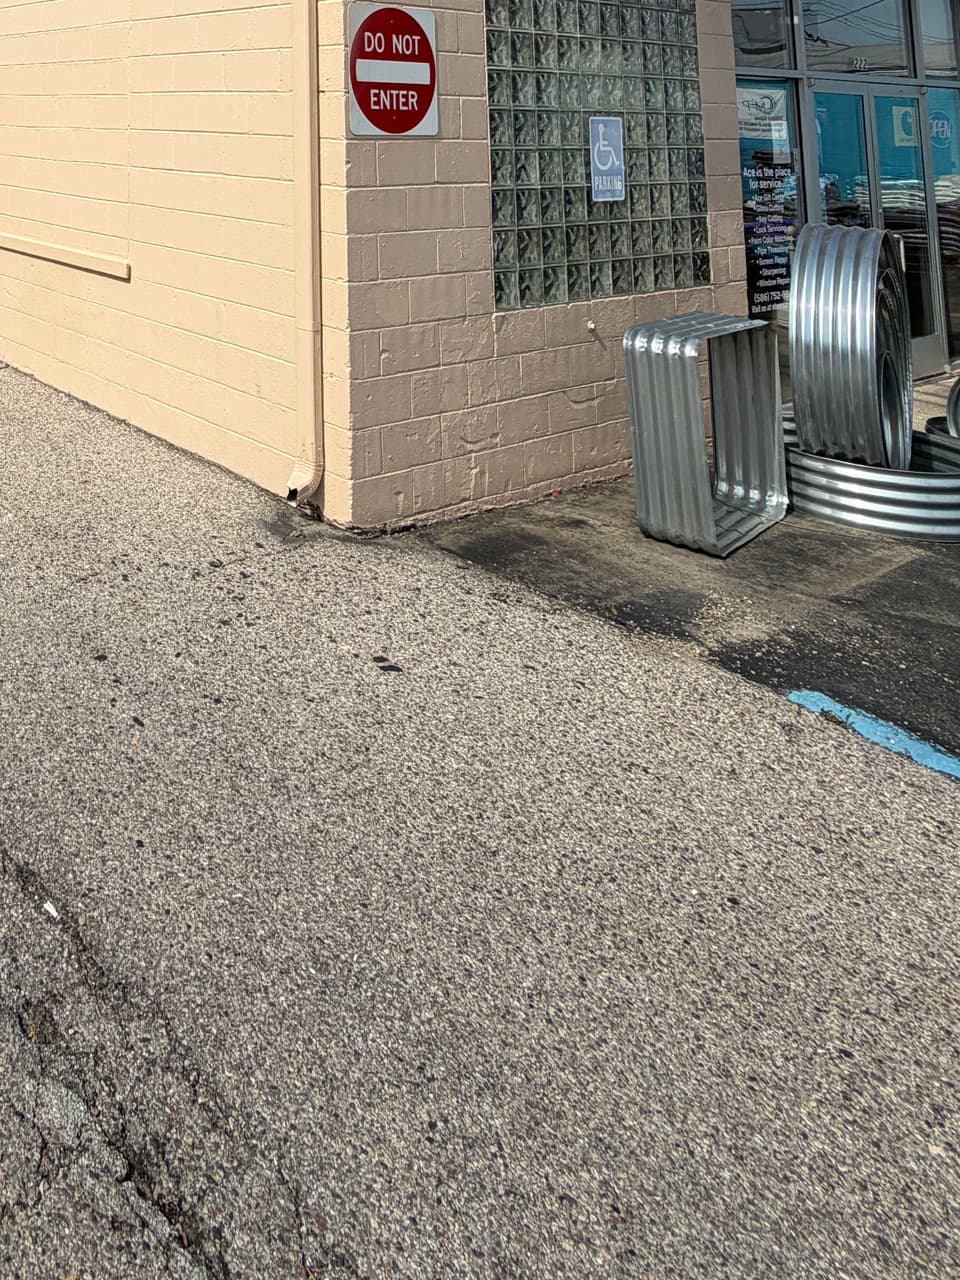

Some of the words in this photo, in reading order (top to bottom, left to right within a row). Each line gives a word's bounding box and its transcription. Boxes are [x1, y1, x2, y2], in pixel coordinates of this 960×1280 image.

[364, 31, 385, 53] DO
[392, 34, 421, 55] NOT
[369, 89, 419, 111] ENTER
[743, 167, 755, 177] Ace
[756, 166, 763, 177] is
[763, 166, 774, 177] the
[775, 166, 791, 179] place
[594, 175, 622, 192] PARKING
[749, 179, 758, 190] for
[756, 225, 767, 233] Lock
[762, 236, 774, 244] Color
[762, 267, 786, 277] Sharpening
